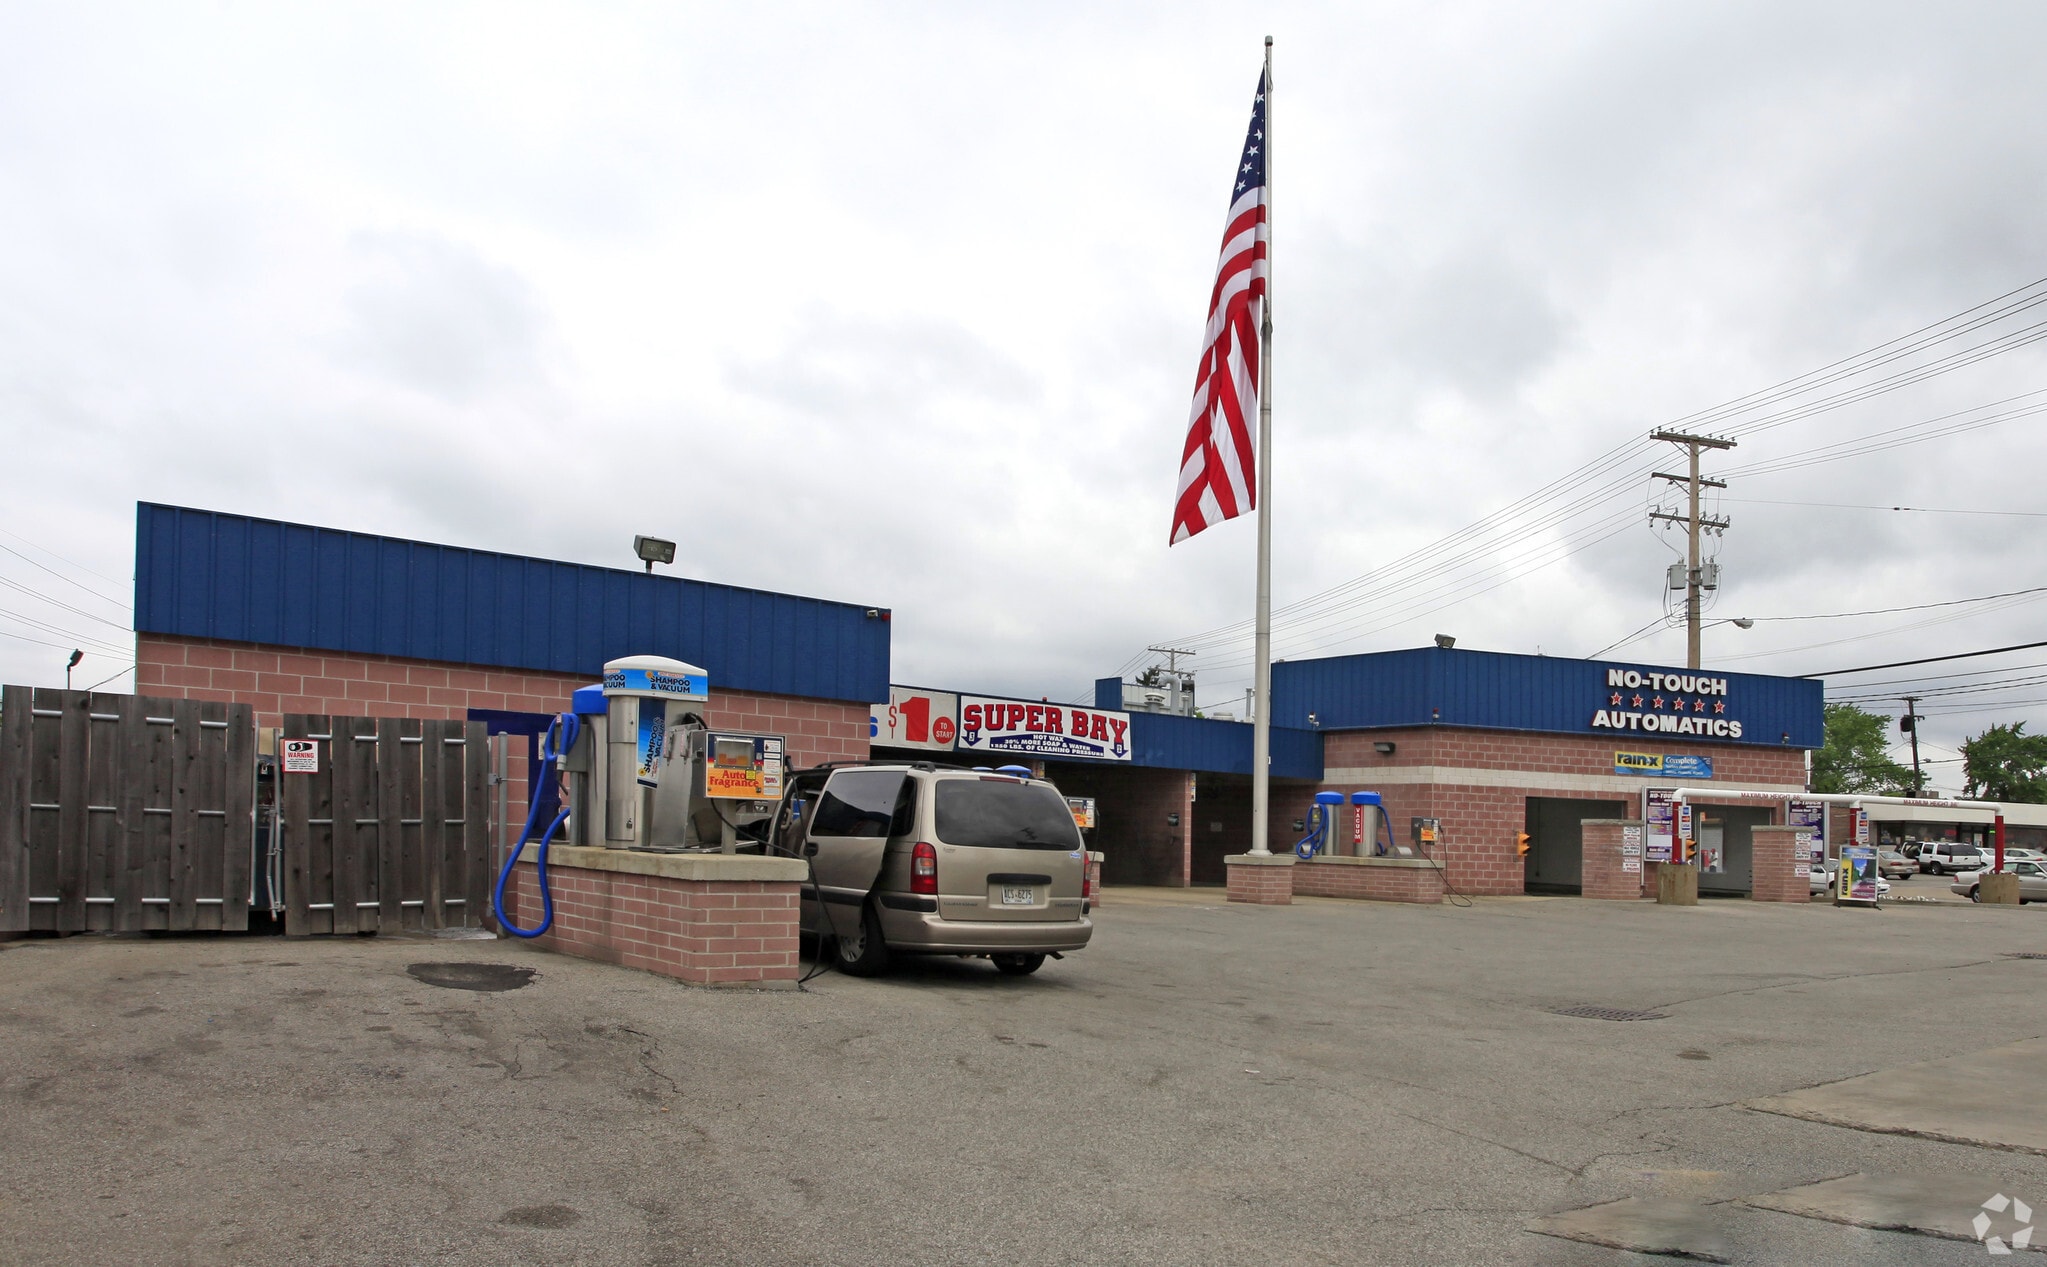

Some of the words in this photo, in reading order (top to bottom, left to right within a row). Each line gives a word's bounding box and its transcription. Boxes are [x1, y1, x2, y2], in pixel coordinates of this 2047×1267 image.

[650, 676, 690, 686] SHAMPOO
[1608, 669, 1727, 695] NO-TOUCH
[659, 685, 690, 693] VACUUM
[964, 704, 1063, 734] SUPER
[1071, 710, 1128, 743] BAY
[1592, 709, 1742, 738] AUTOMATICS
[1037, 745, 1070, 753] CLEANING
[1069, 743, 1090, 751] WATER
[1666, 757, 1697, 765] Complete
[722, 770, 746, 779] Auto
[710, 776, 759, 788] Fragrance
